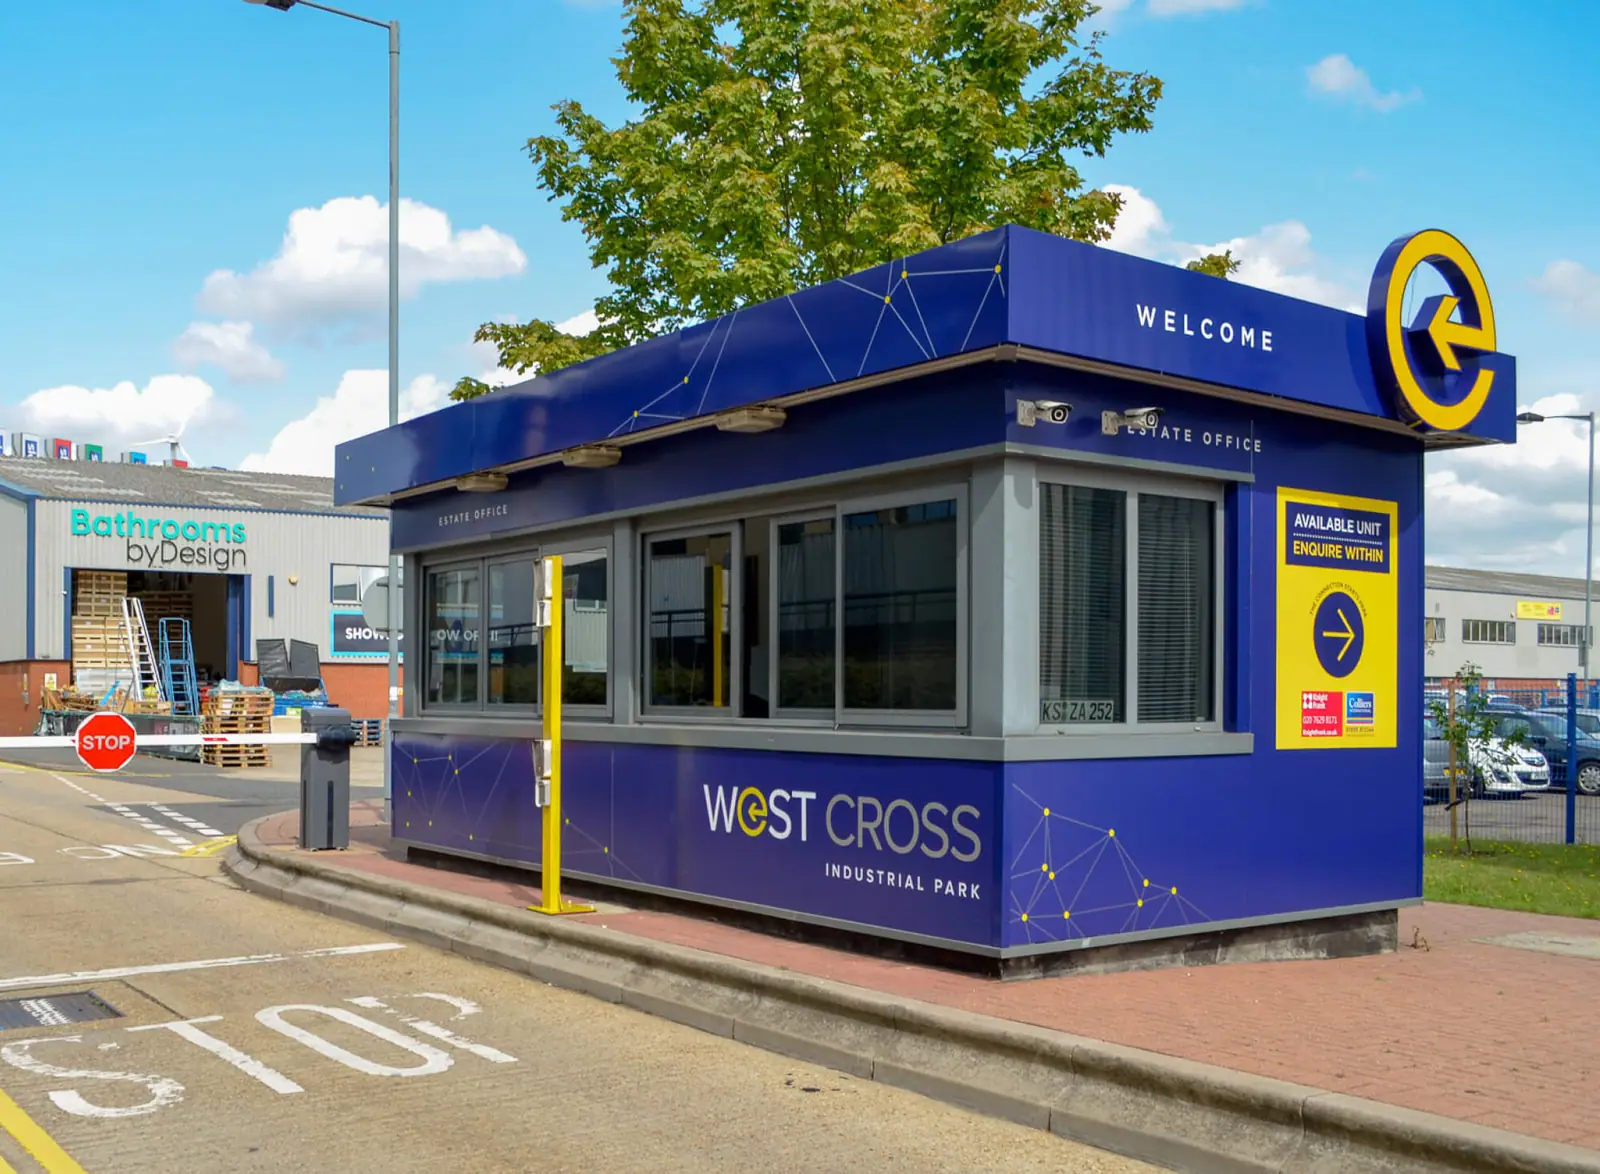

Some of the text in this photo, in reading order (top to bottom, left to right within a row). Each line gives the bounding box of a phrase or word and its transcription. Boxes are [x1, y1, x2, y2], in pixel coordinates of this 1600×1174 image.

[1136, 303, 1274, 353] WELCOME
[1202, 431, 1261, 453] OFFICE
[71, 508, 247, 543] Bathrooms
[438, 504, 508, 526] ESTATE OFFICE
[1294, 513, 1382, 536] AVAILABLE UNIT
[126, 538, 247, 571] byDesign
[1293, 540, 1384, 563] ENQUIRE WITHIN
[1042, 702, 1113, 721] KS ZA 252
[1348, 697, 1372, 708] Colliers
[82, 734, 131, 750] STOP
[825, 793, 982, 862] CROSS
[825, 862, 982, 901] INDUSTRIAL PARK
[0, 992, 519, 1118] STOP
